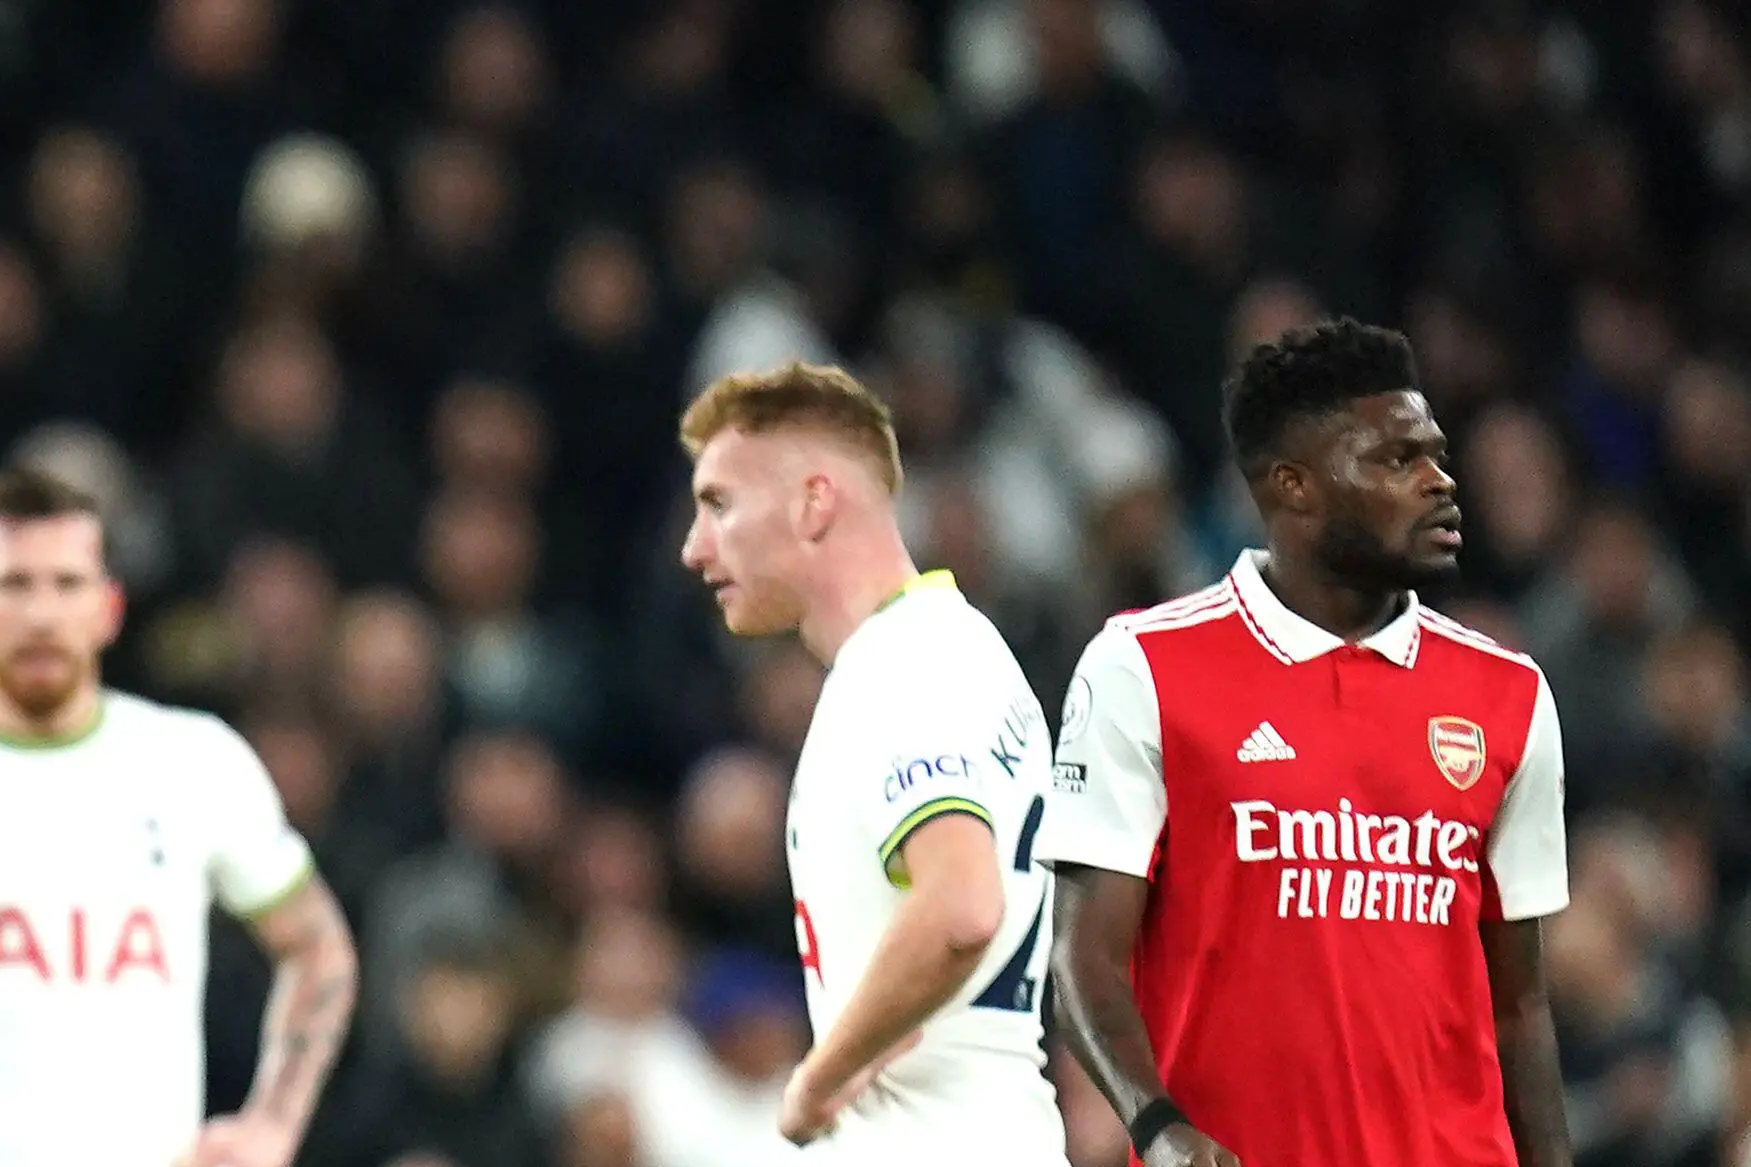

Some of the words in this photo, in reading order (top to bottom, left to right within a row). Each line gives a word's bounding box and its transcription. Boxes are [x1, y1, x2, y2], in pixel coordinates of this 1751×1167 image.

[1229, 797, 1481, 873] Emirates
[1277, 867, 1333, 919] FLY
[1339, 869, 1457, 926] BETTER
